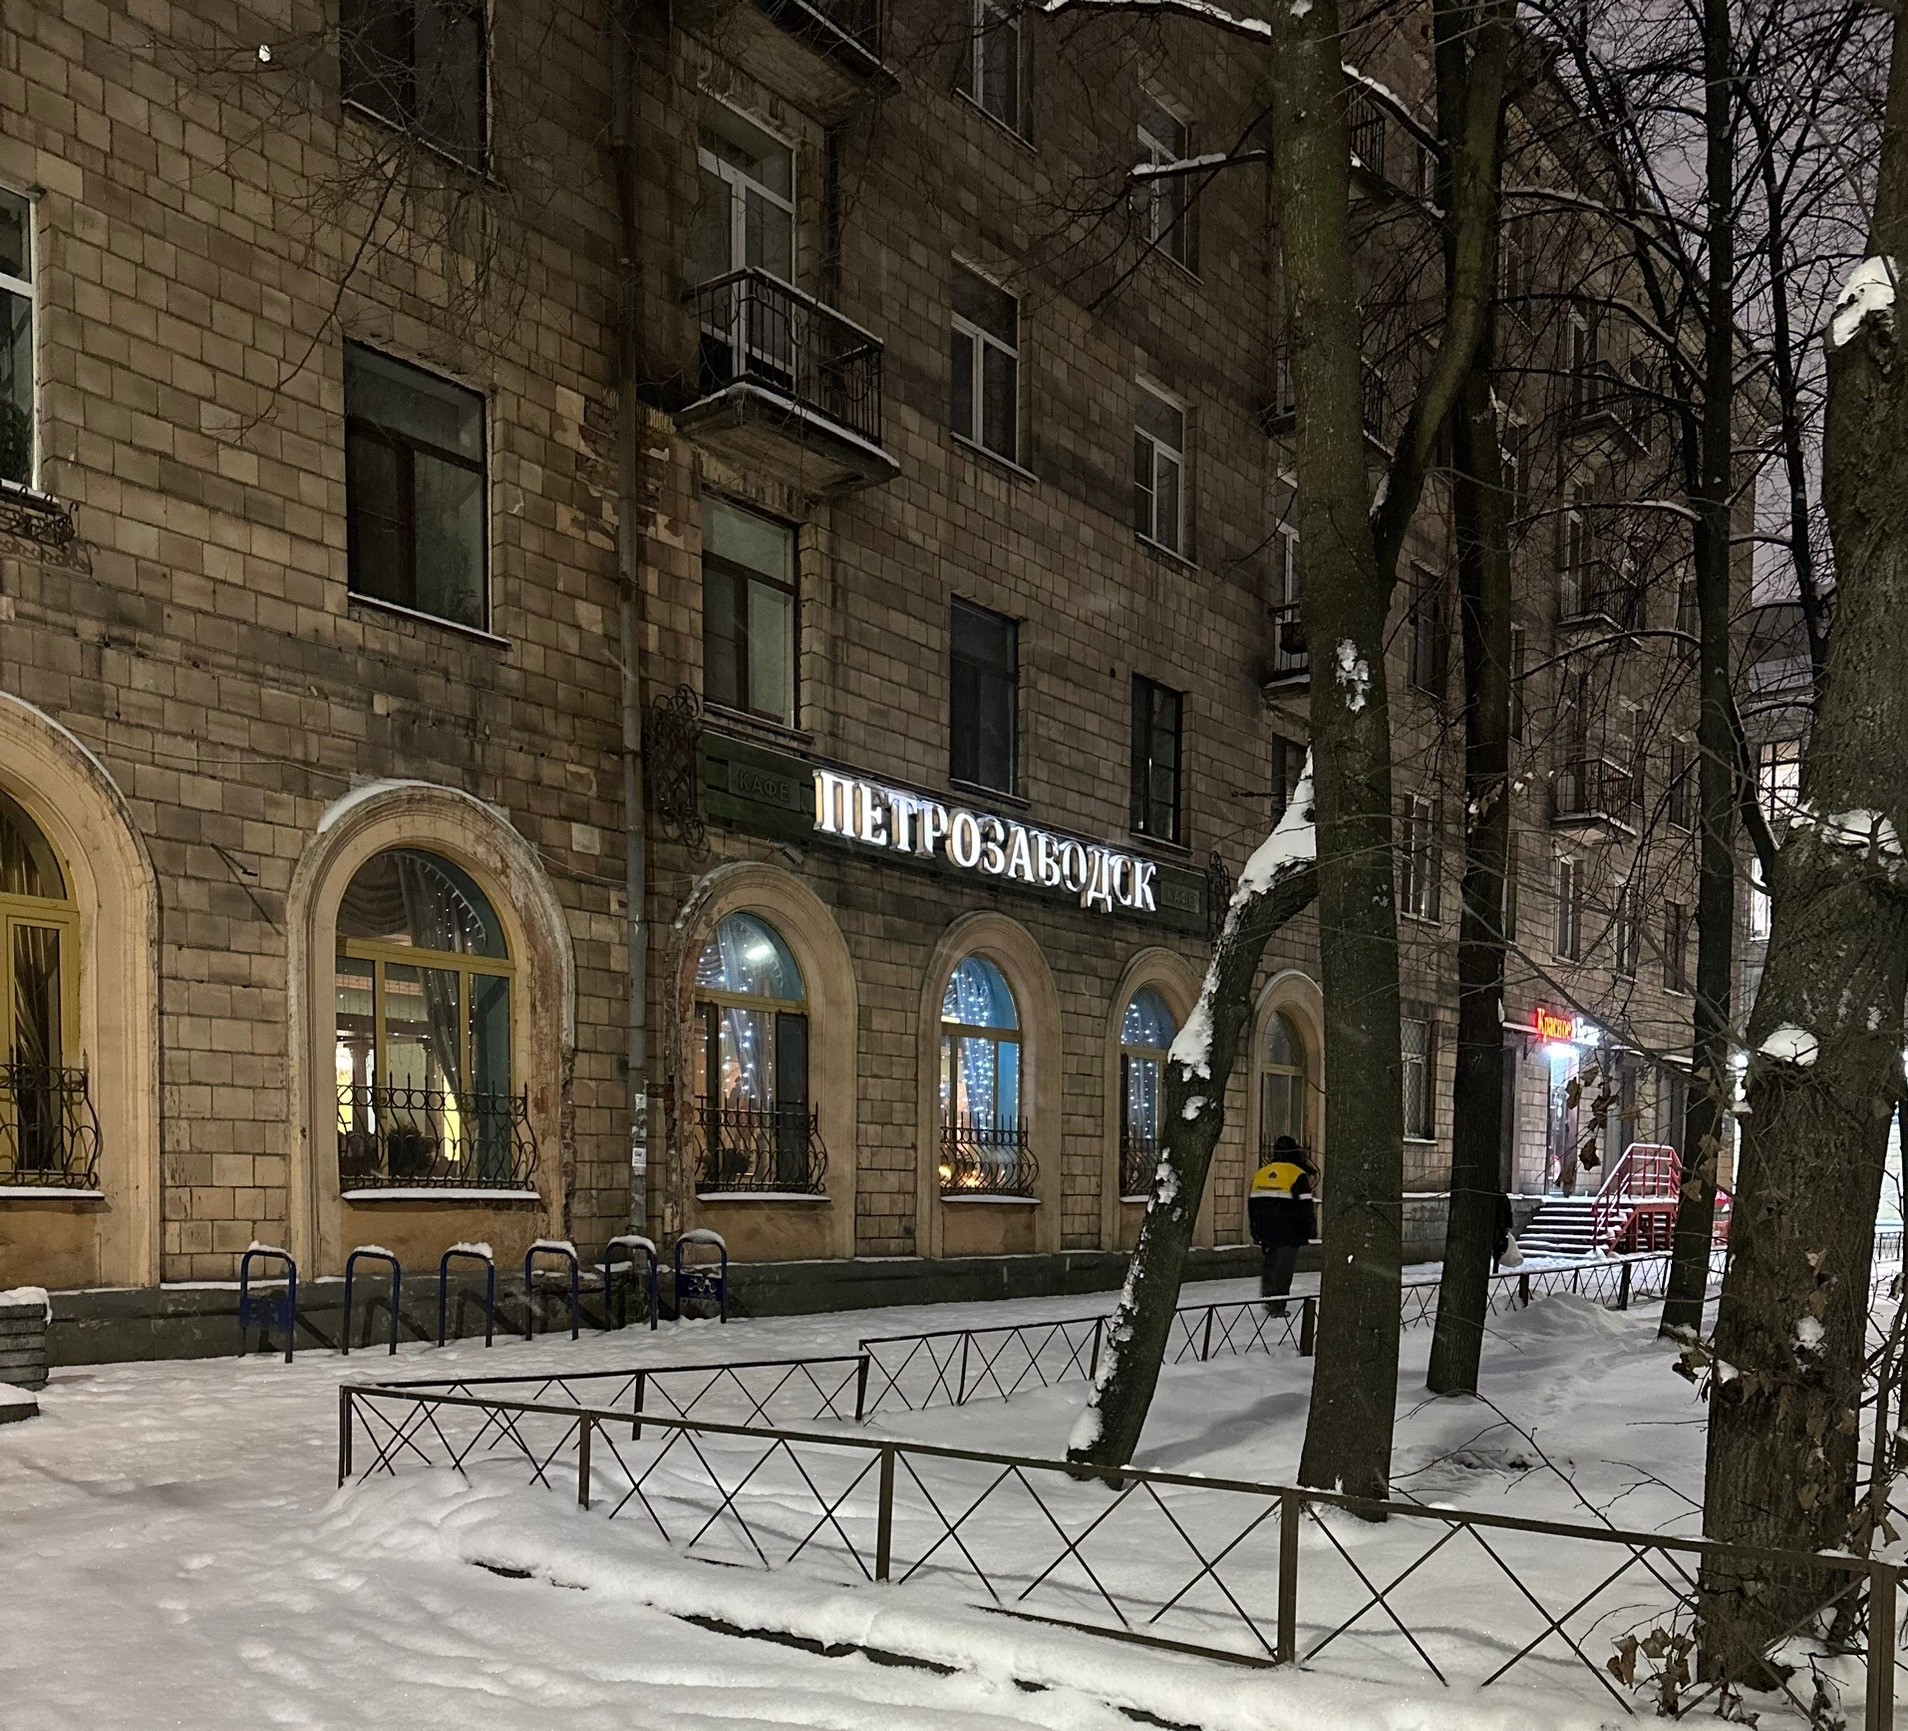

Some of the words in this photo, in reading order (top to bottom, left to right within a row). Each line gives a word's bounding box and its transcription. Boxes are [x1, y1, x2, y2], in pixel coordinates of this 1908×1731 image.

[738, 770, 791, 804] КАФЕ
[813, 769, 1157, 913] ПЕТРОЗАВОДСК
[1536, 1008, 1572, 1042] Красное
